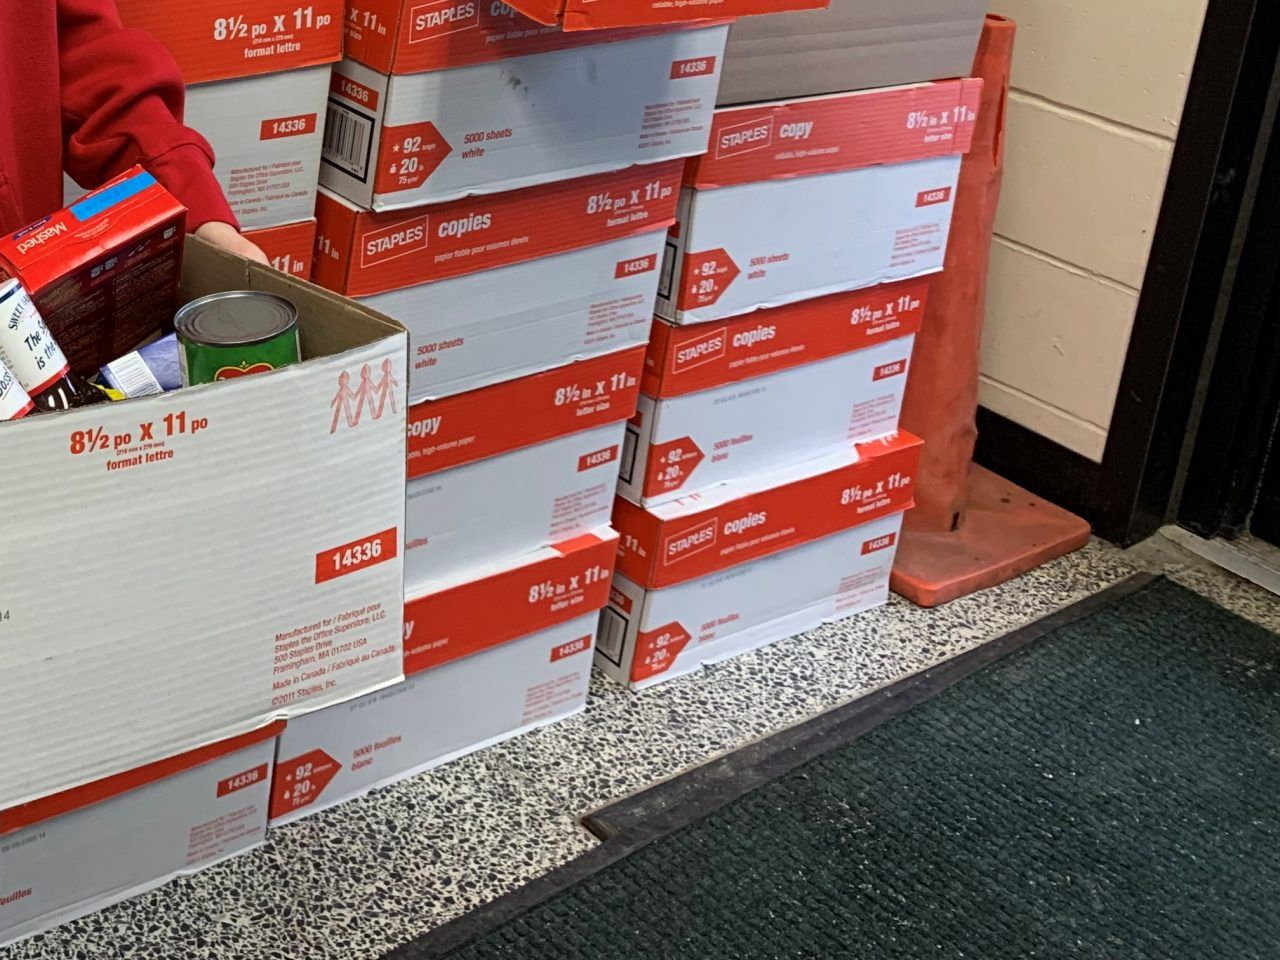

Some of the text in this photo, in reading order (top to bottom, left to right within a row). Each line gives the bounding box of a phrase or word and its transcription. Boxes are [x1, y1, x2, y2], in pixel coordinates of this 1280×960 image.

[415, 1, 475, 31] STAPLES
[244, 41, 301, 58] format lettre
[679, 59, 707, 73] 14336
[340, 79, 370, 102] 14336
[272, 119, 306, 134] 14336
[464, 126, 513, 145] 5000 sheets
[720, 120, 813, 149] STAPLES copy
[403, 136, 421, 153] 92
[462, 145, 485, 160] white
[17, 221, 68, 255] Mashed
[367, 211, 492, 257] STAPLES copies
[623, 258, 649, 274] 14336
[677, 324, 777, 364] STAPLES copies
[69, 425, 110, 455] 8½
[113, 432, 132, 450] po
[162, 411, 186, 437] 11
[191, 417, 209, 433] po
[106, 449, 174, 471] format lettre
[668, 511, 767, 556] STAPLES copies
[332, 539, 382, 570] 14336
